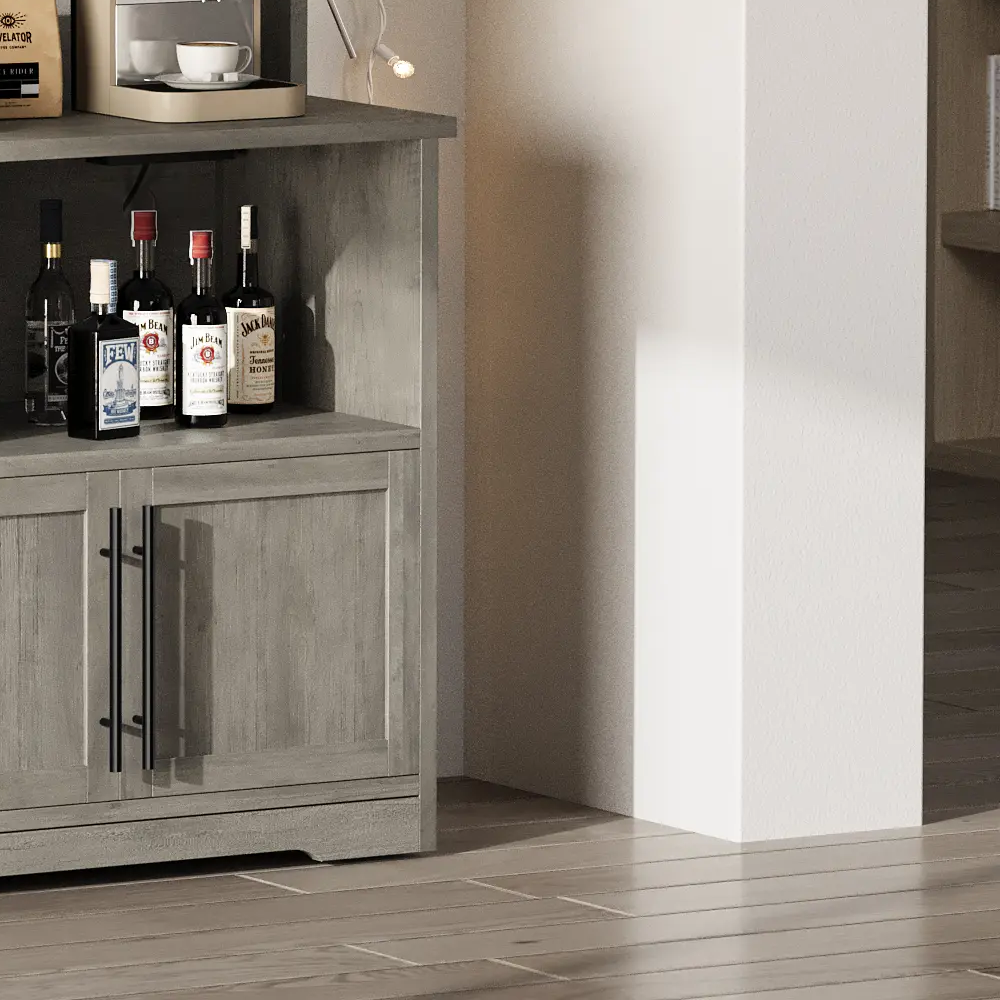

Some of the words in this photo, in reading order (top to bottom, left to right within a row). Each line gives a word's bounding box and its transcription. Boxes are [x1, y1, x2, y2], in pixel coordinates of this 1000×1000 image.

[148, 318, 168, 336] BEAM
[240, 317, 261, 338] JACK
[190, 335, 204, 350] JIM
[205, 332, 223, 349] BEAM
[105, 342, 136, 367] FEW
